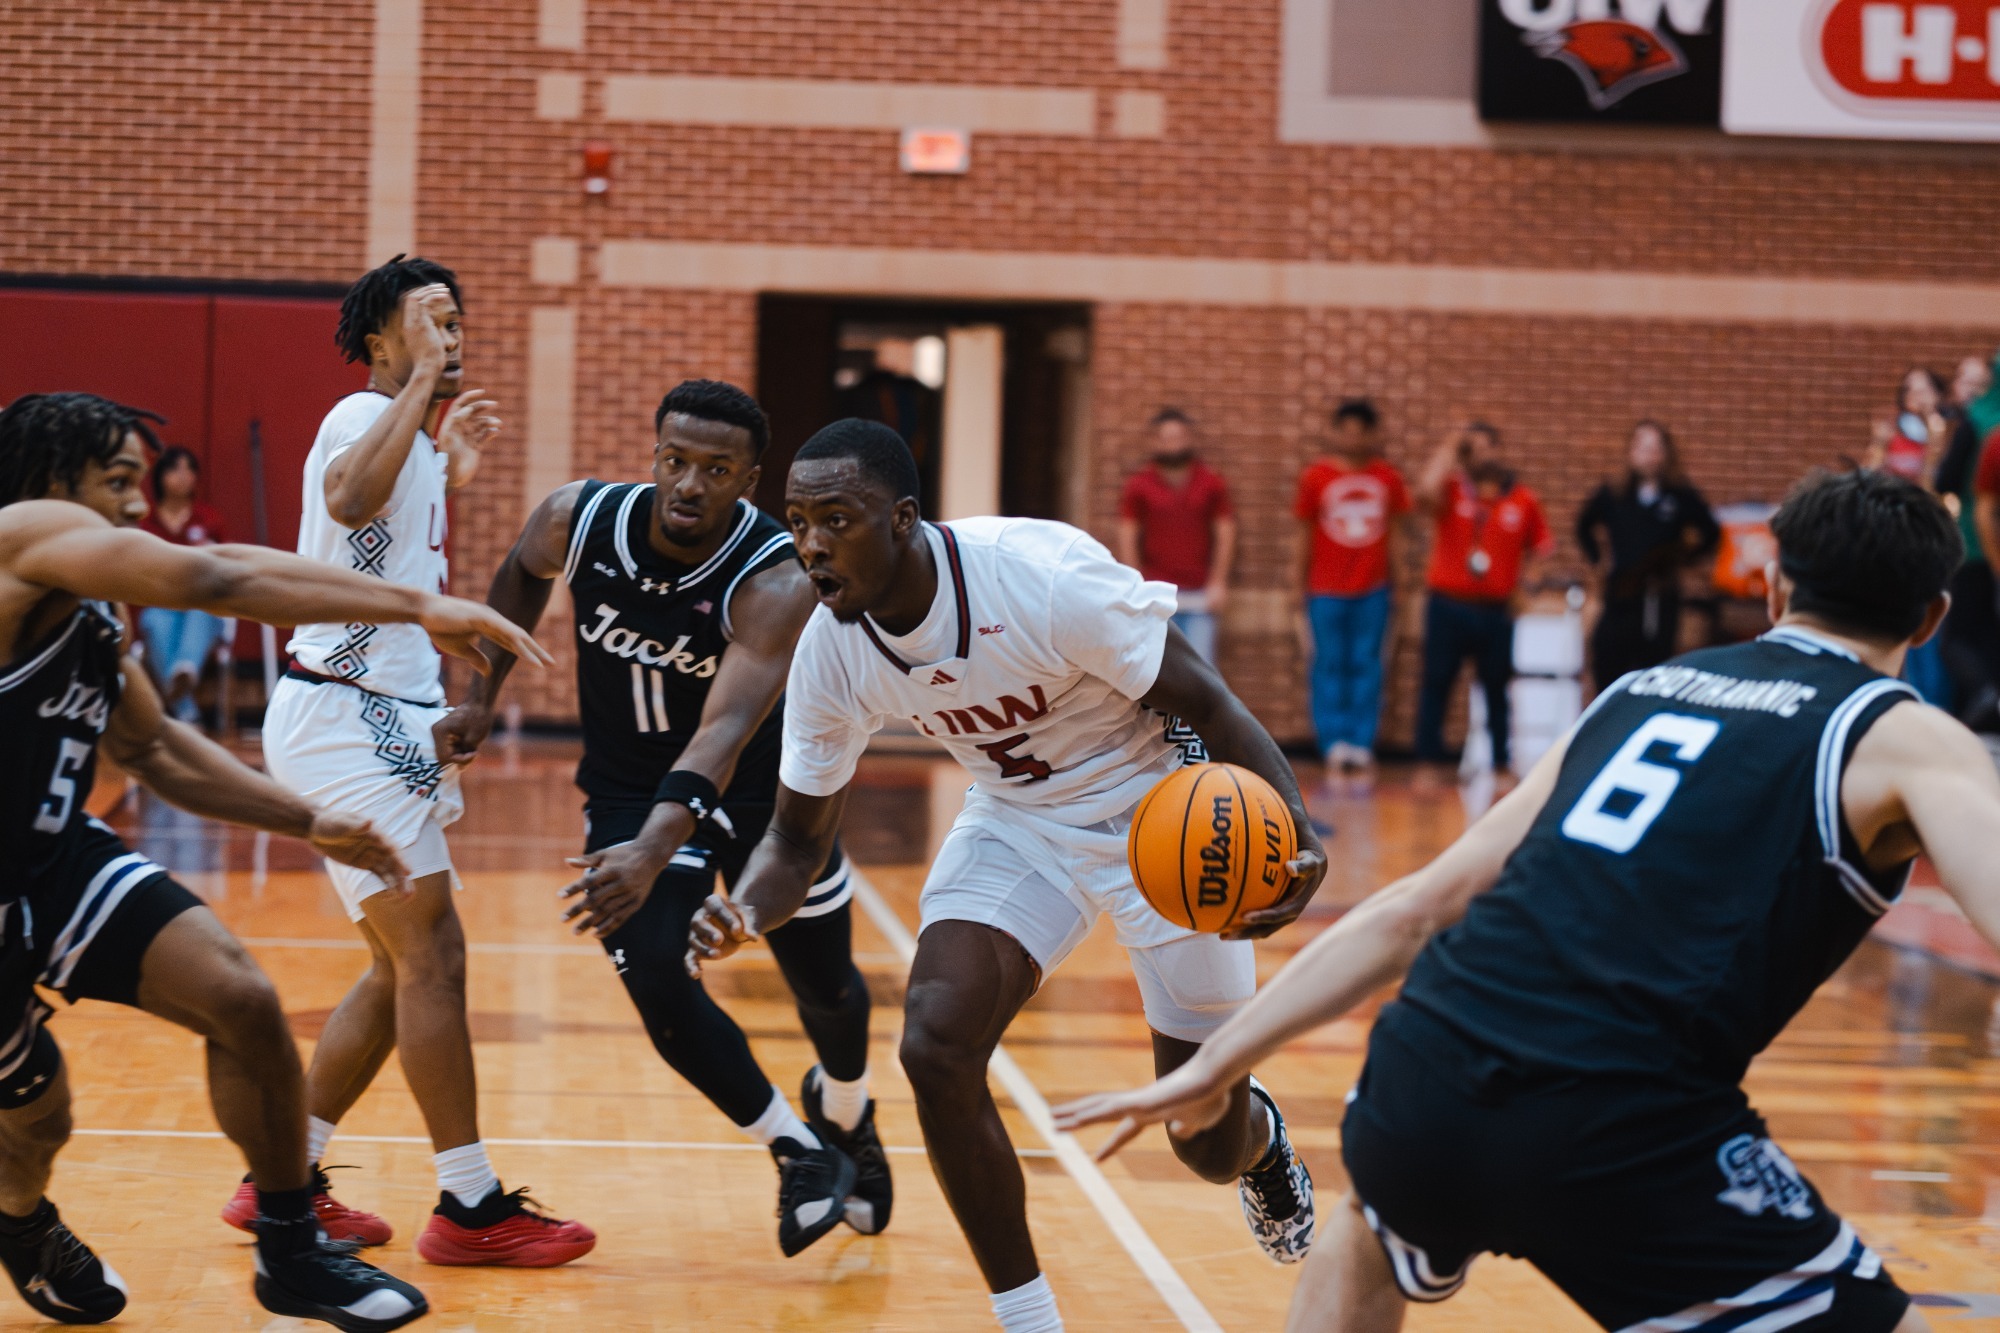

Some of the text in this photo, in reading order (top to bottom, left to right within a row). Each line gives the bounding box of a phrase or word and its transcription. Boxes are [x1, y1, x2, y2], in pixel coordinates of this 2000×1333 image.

[1861, 4, 2000, 85] H-
[579, 603, 718, 678] Jacks
[630, 663, 671, 732] 11
[33, 737, 93, 834] 5
[975, 732, 1052, 783] 5
[1561, 712, 1721, 854] 6
[1197, 795, 1233, 909] Wilson
[1261, 817, 1281, 888] EVO
